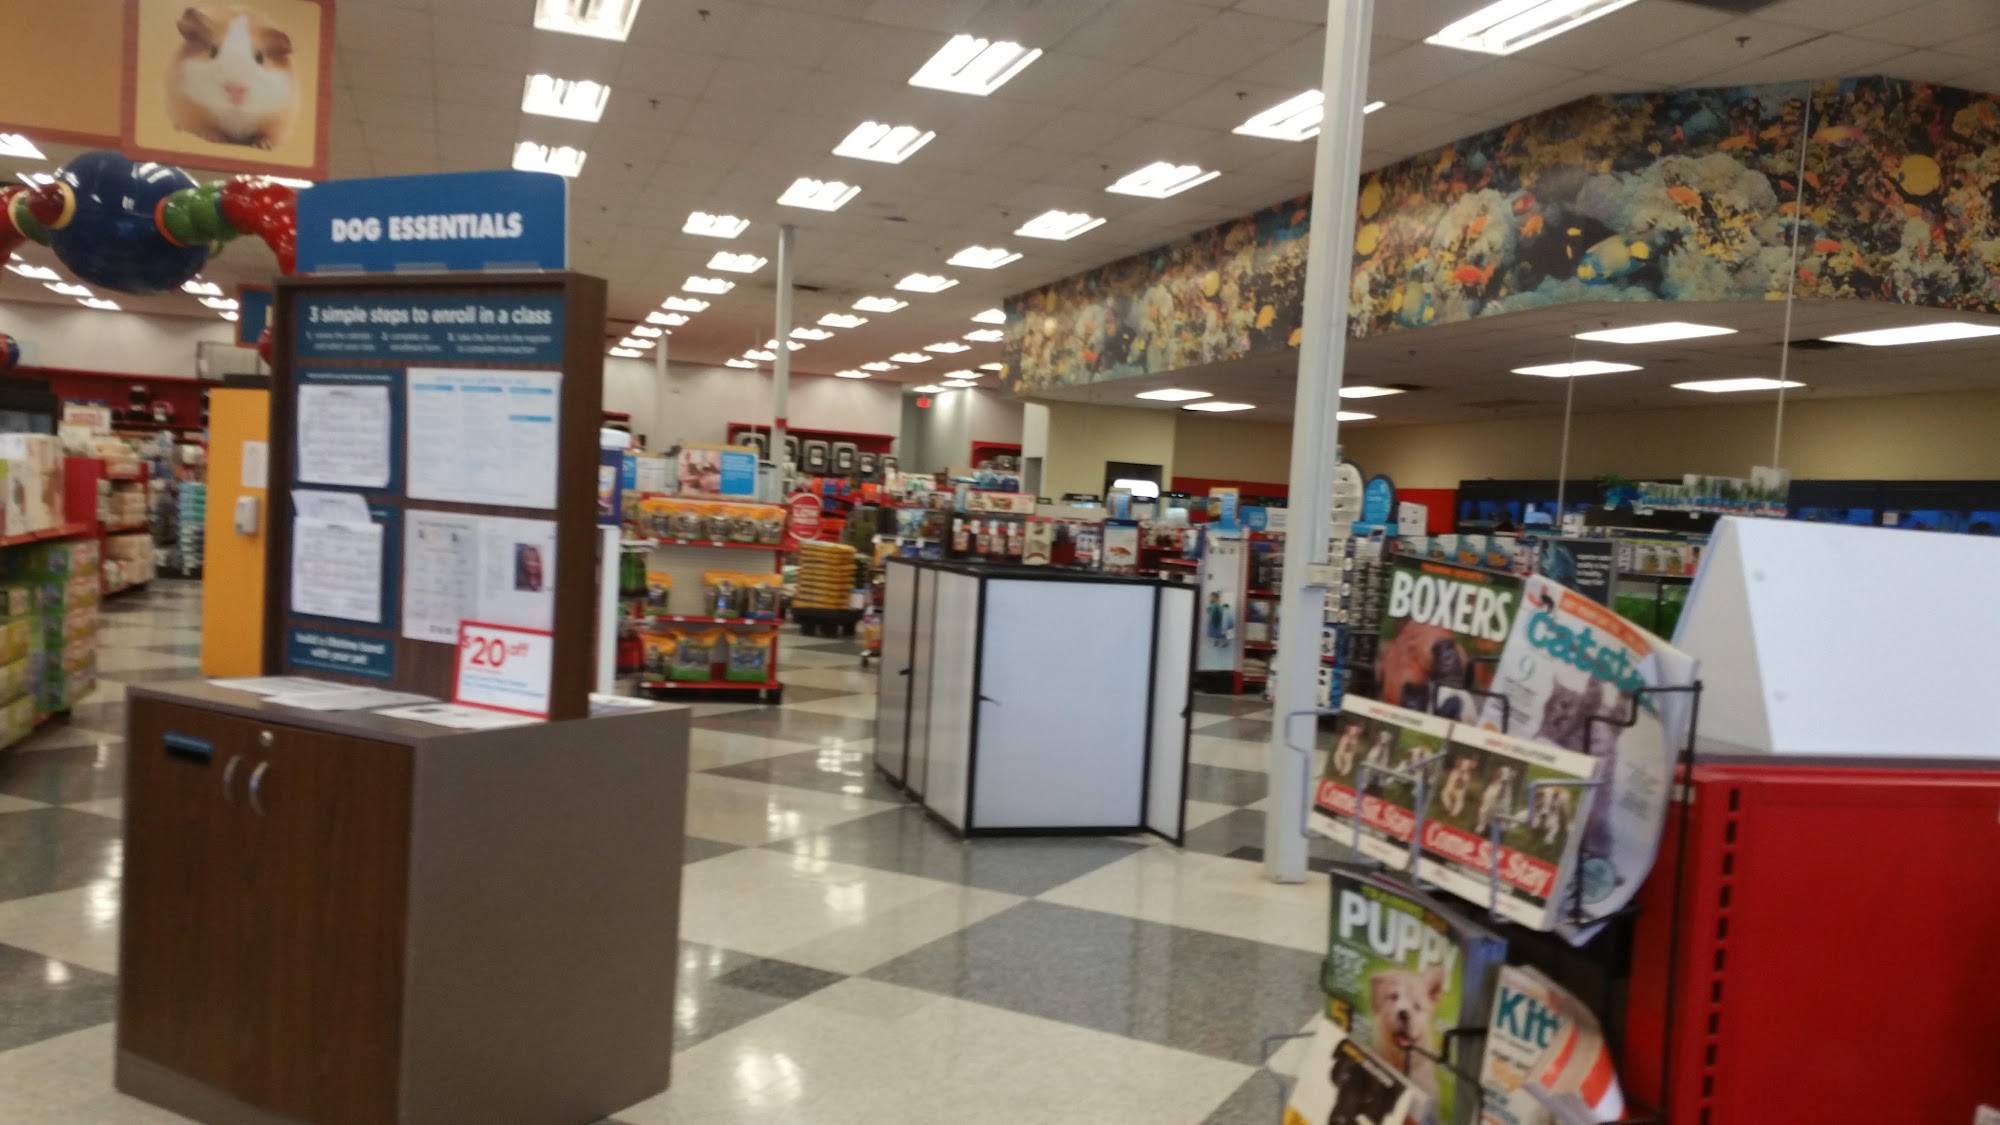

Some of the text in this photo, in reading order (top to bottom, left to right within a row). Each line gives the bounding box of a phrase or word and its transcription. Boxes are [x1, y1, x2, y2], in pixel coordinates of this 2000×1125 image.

[331, 211, 523, 243] DOG ESSENTIALS
[309, 305, 552, 327] 3 simple steps to enroll in a class
[1388, 570, 1513, 643] BOXERS
[462, 636, 506, 668] $20
[1339, 889, 1460, 993] PUPPY
